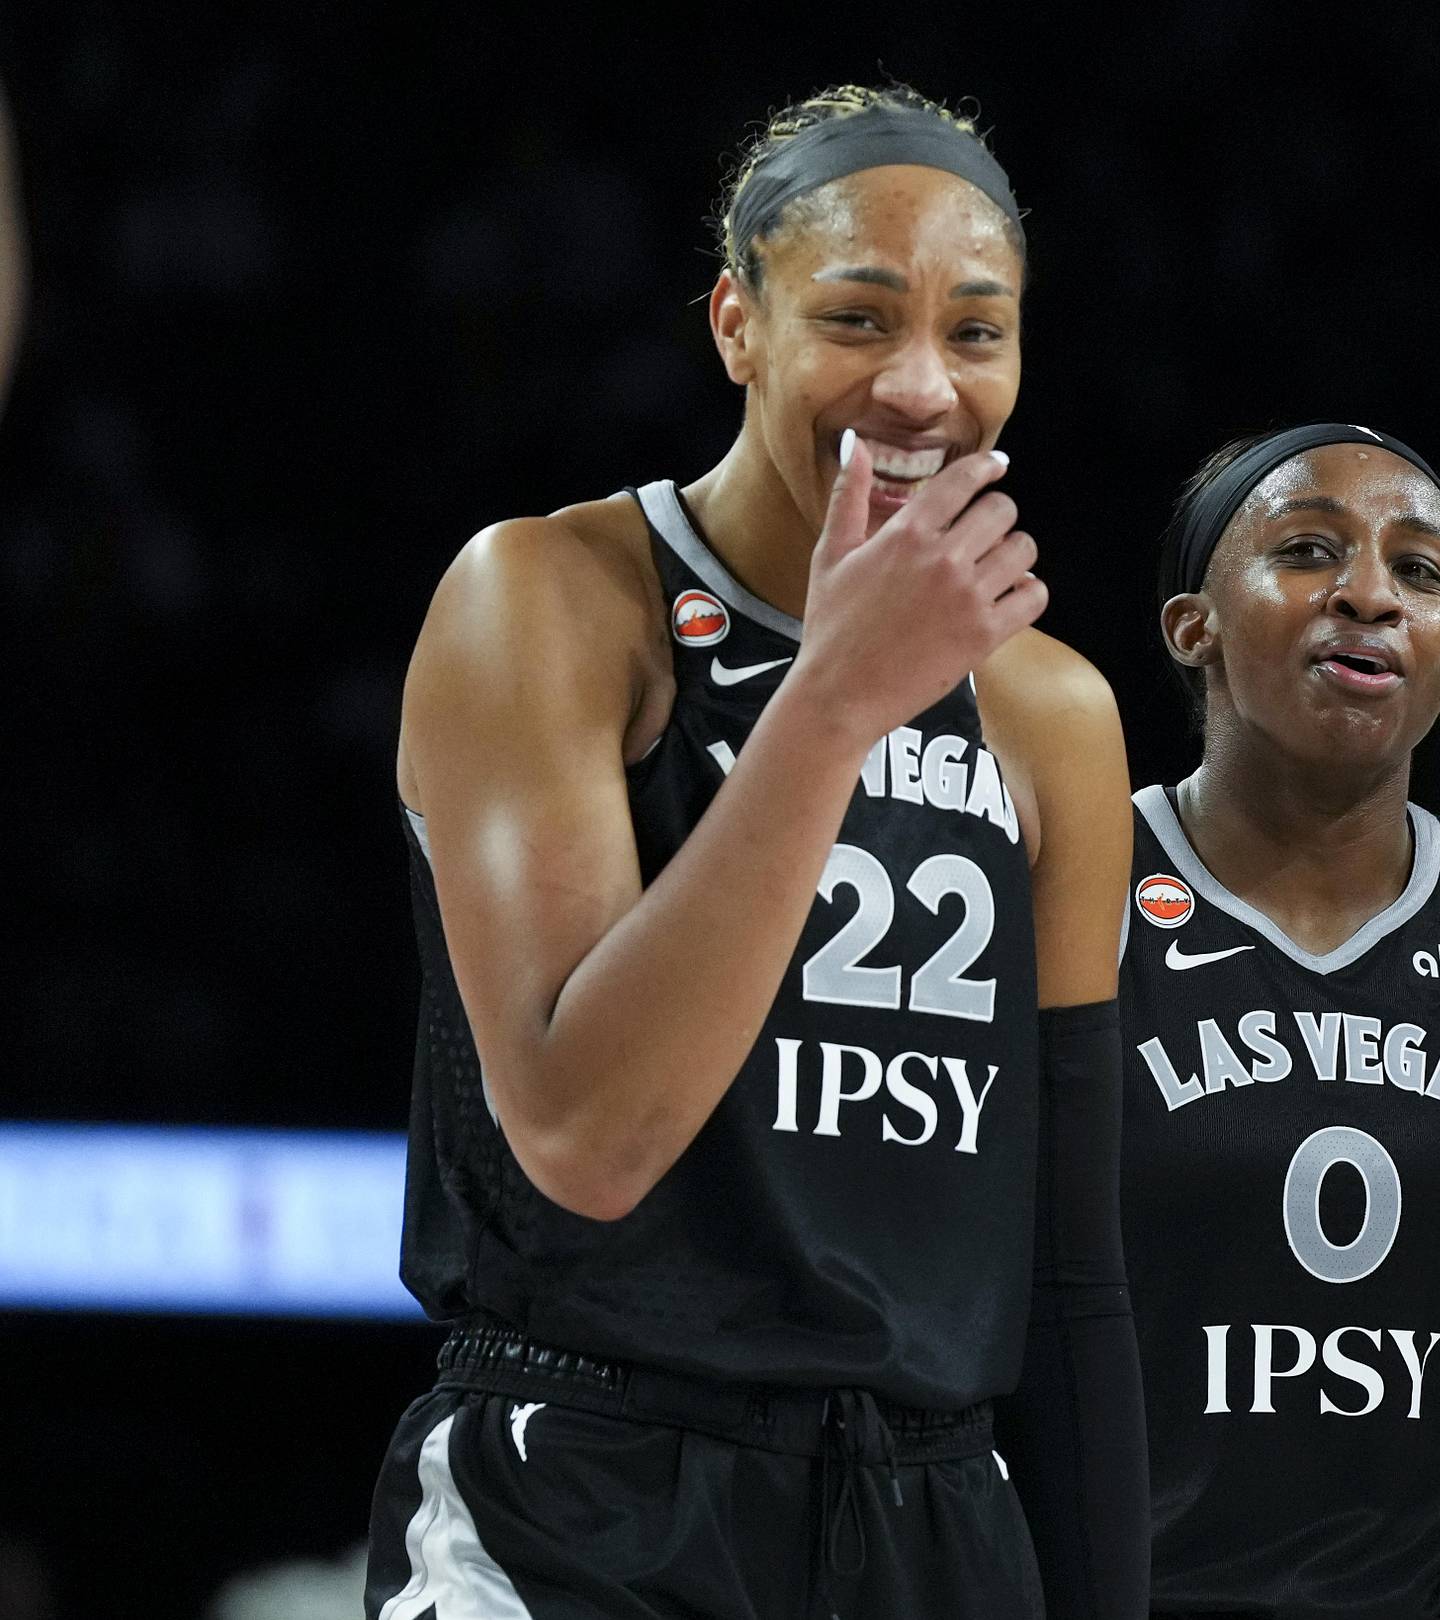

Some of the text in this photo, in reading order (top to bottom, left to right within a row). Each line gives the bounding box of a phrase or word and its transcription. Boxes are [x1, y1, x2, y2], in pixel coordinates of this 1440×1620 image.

[803, 843, 997, 1023] 22
[772, 1037, 1000, 1155] IPSY
[1137, 1010, 1293, 1112] LAS
[1282, 1125, 1403, 1284] 0
